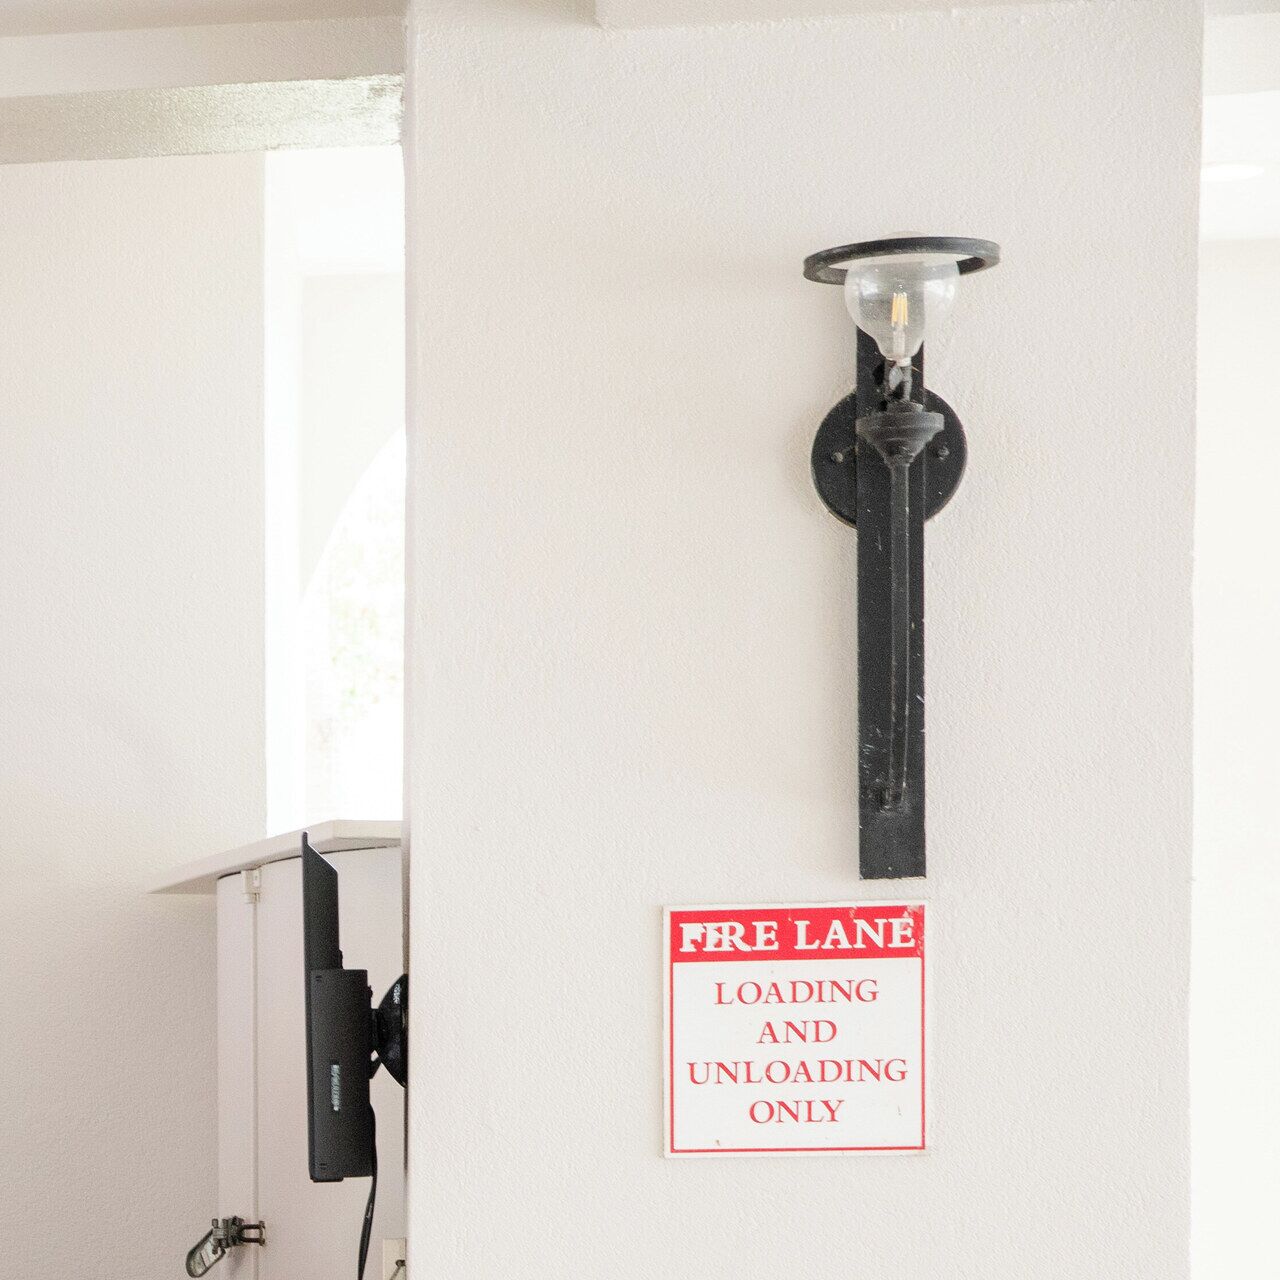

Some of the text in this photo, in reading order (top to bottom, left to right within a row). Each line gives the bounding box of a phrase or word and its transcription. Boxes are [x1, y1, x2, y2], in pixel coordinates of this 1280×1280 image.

[793, 917, 916, 951] LANE
[714, 978, 879, 1005] LOADING
[755, 1019, 838, 1044] AND
[686, 1058, 908, 1085] UNLOADING
[748, 1099, 845, 1124] ONLY
